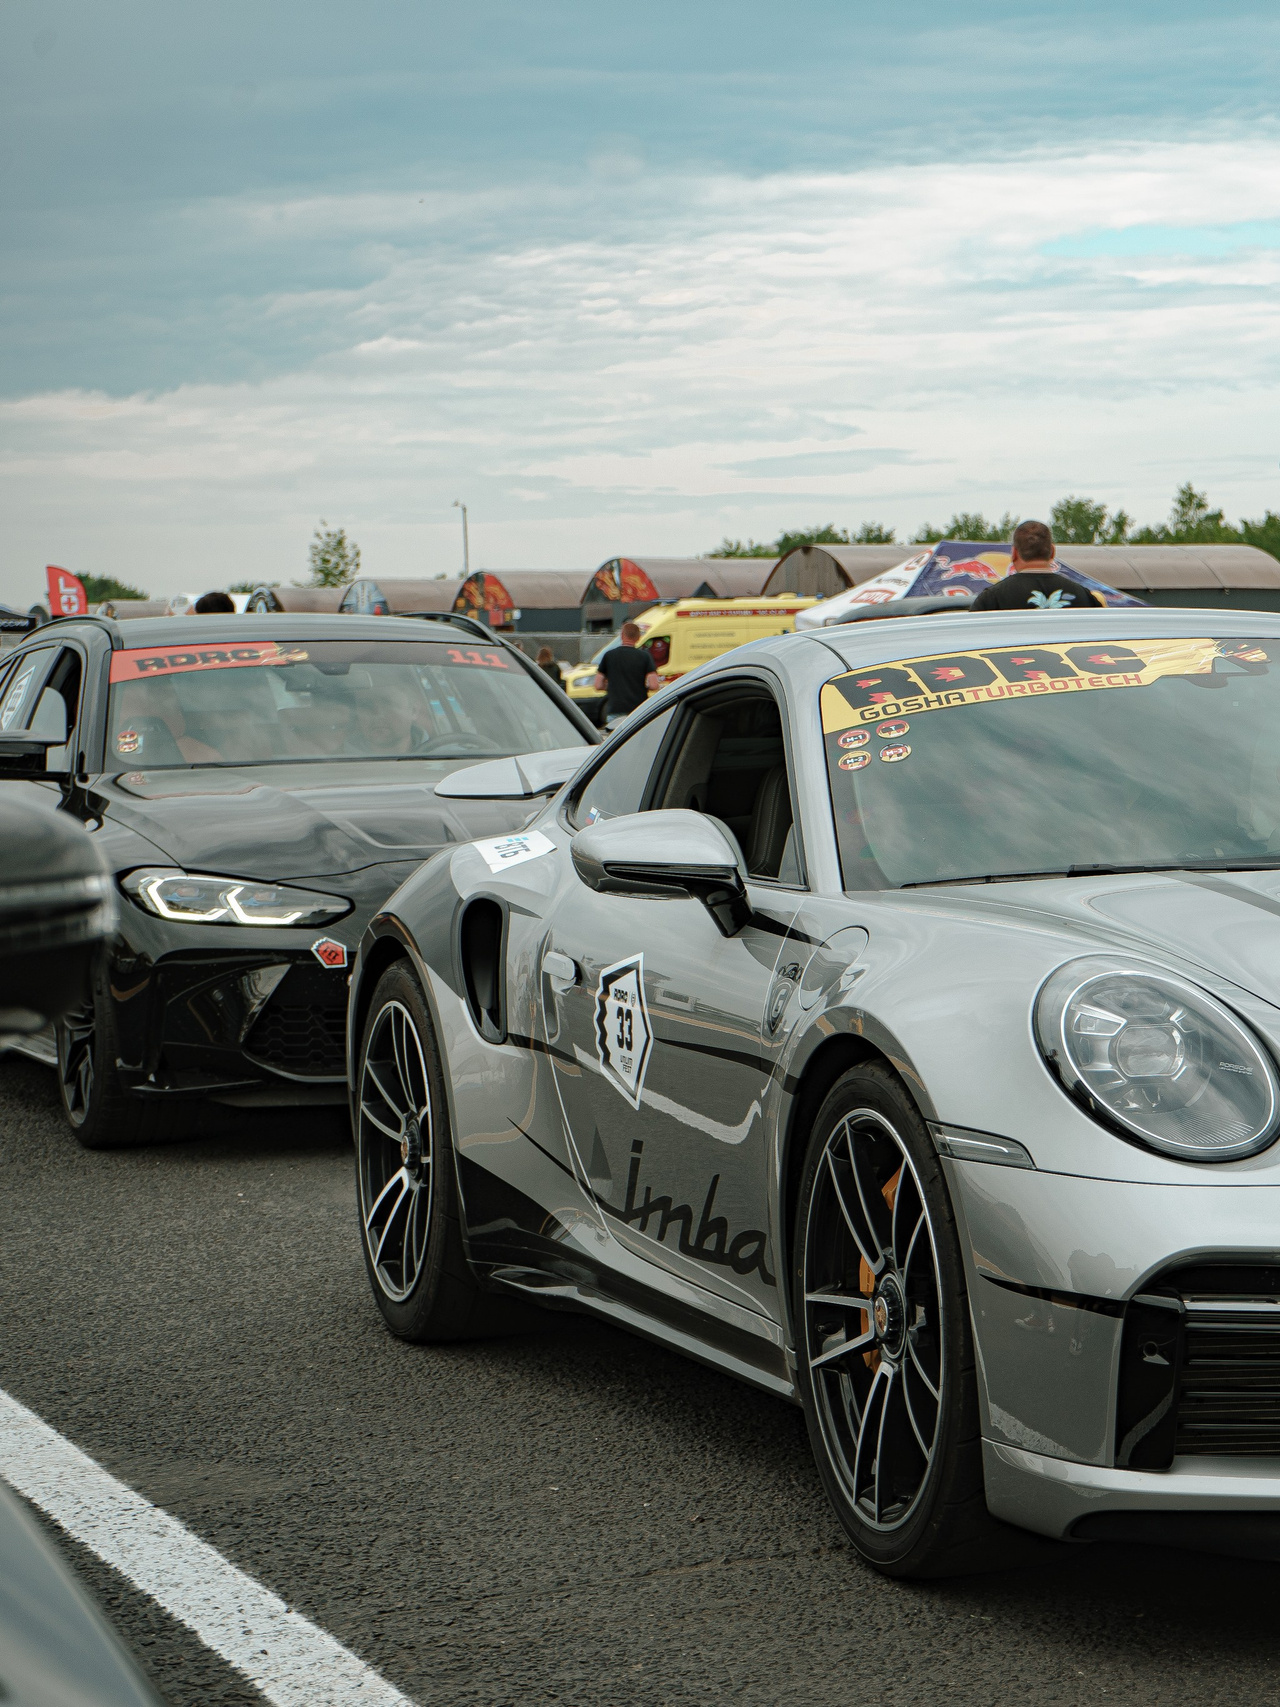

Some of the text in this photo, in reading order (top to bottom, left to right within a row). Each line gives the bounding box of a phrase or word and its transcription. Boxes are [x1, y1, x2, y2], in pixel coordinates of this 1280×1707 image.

[133, 649, 261, 672] RDRC
[447, 649, 508, 669] 111
[829, 645, 1148, 710] RDRC
[859, 674, 1142, 720] GOSHATURBOTECH
[616, 1006, 633, 1052] 33
